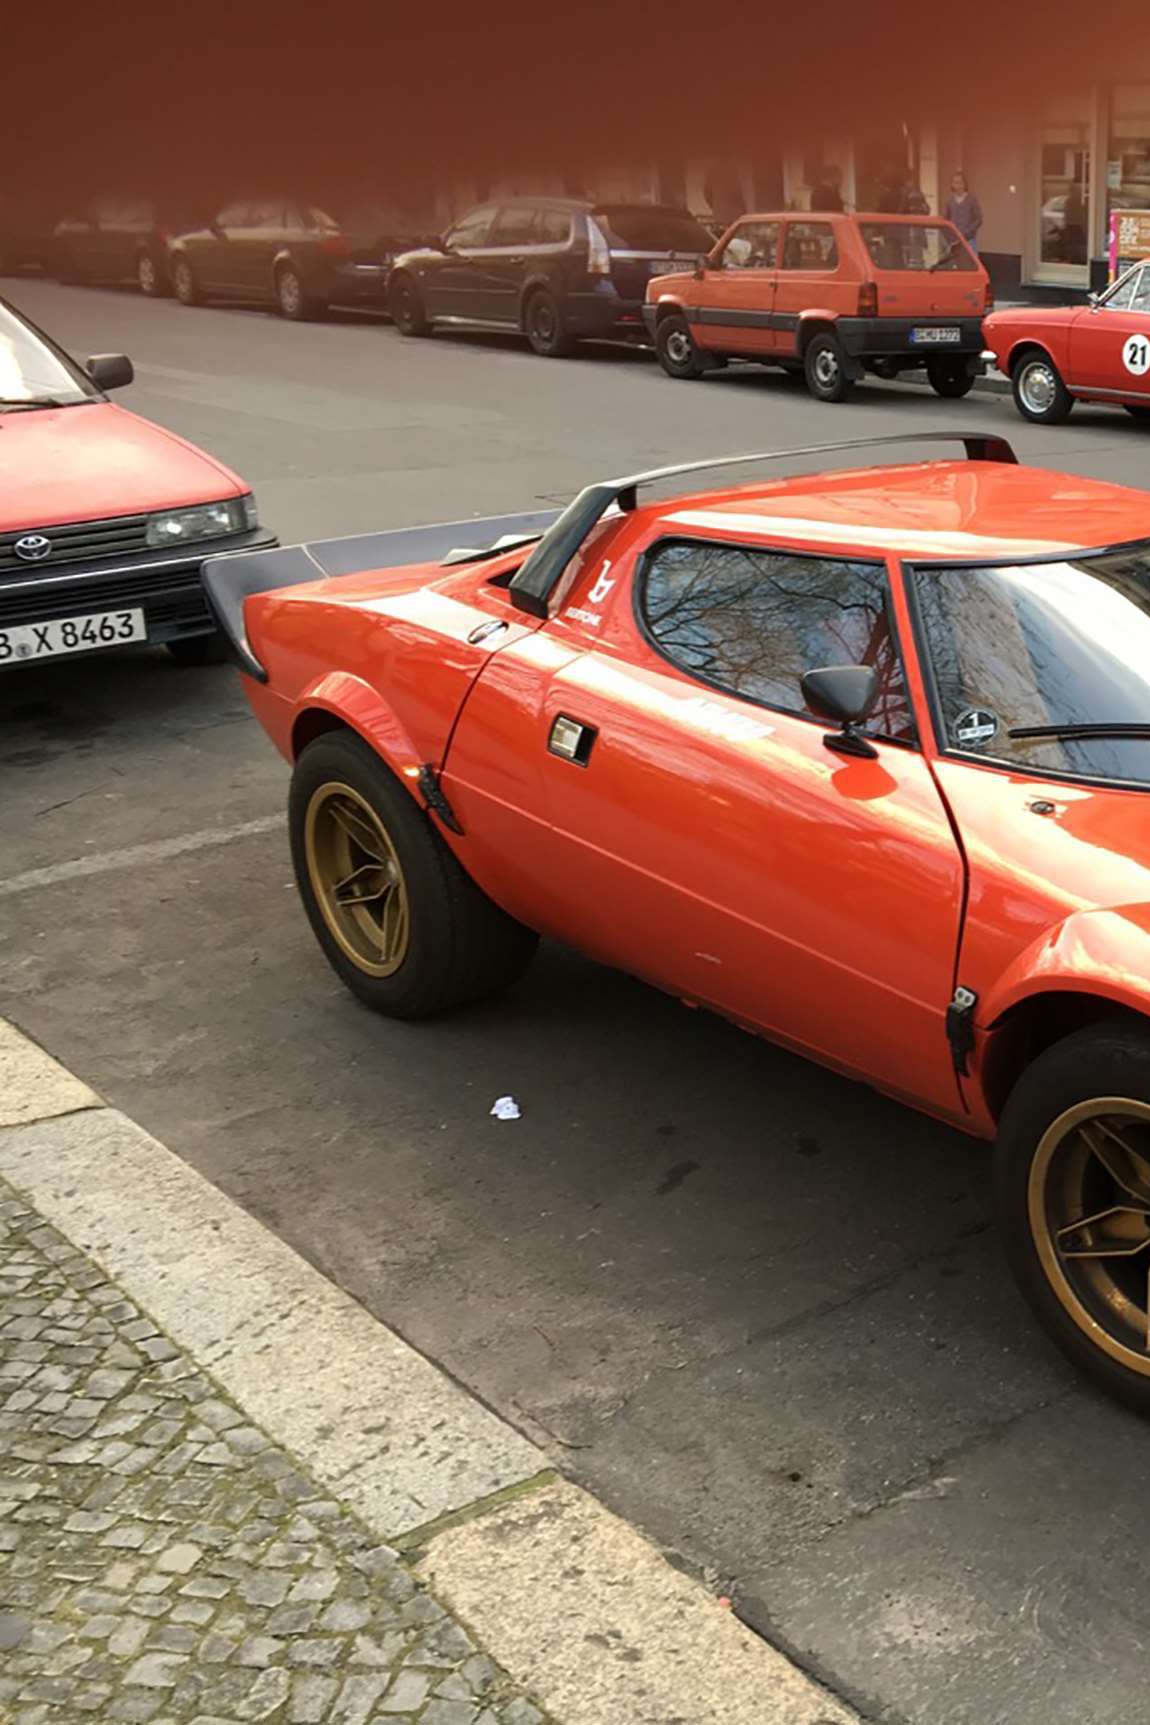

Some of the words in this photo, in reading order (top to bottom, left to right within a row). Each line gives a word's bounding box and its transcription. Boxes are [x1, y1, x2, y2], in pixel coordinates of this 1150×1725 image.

[1129, 342, 1147, 366] 21
[0, 633, 12, 660] B
[32, 626, 53, 653] X
[61, 613, 134, 648] 8463
